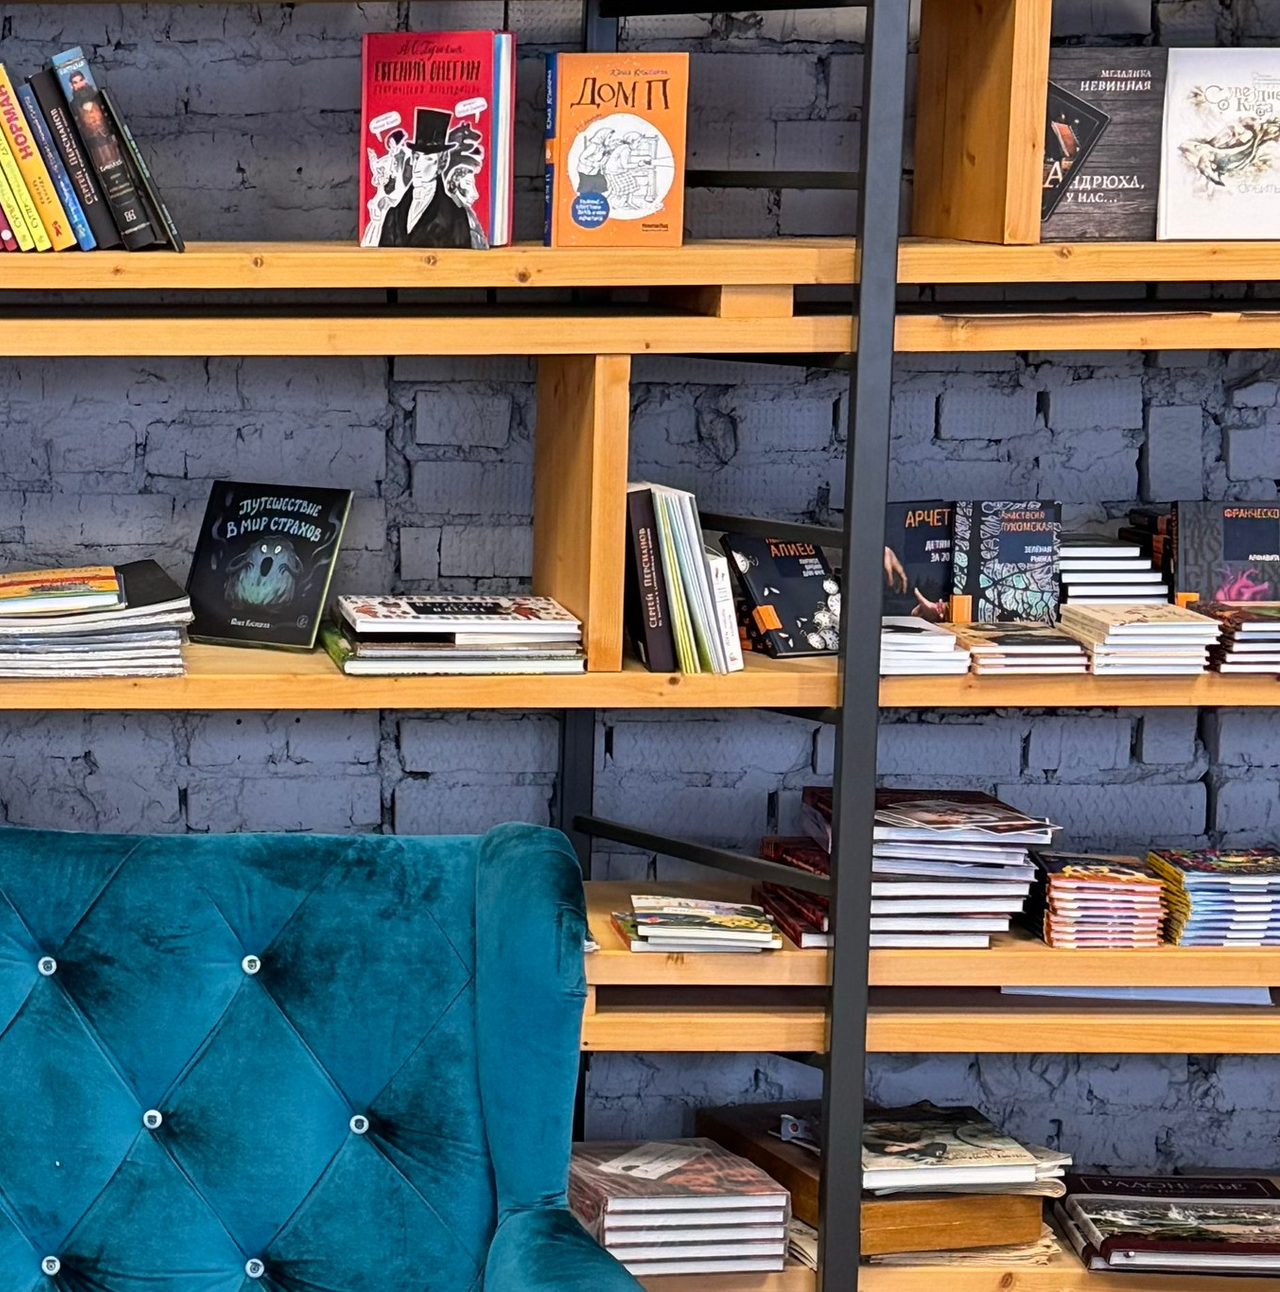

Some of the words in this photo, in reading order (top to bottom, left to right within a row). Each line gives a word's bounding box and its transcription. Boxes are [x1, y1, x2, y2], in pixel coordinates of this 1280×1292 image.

[373, 59, 426, 83] ЕВГЕНИЙ
[429, 59, 482, 83] ОНЕГИН
[645, 78, 671, 110] П
[1080, 80, 1152, 92] НЕВИННАЯ
[239, 496, 323, 518] ПУТЕШЕСТВИЕ
[904, 508, 951, 528] АРЧЕТ
[226, 521, 238, 538] В
[240, 517, 269, 535] МИР
[269, 517, 323, 542] СТРАХОВ
[646, 593, 659, 629] СЕРГЕЙ
